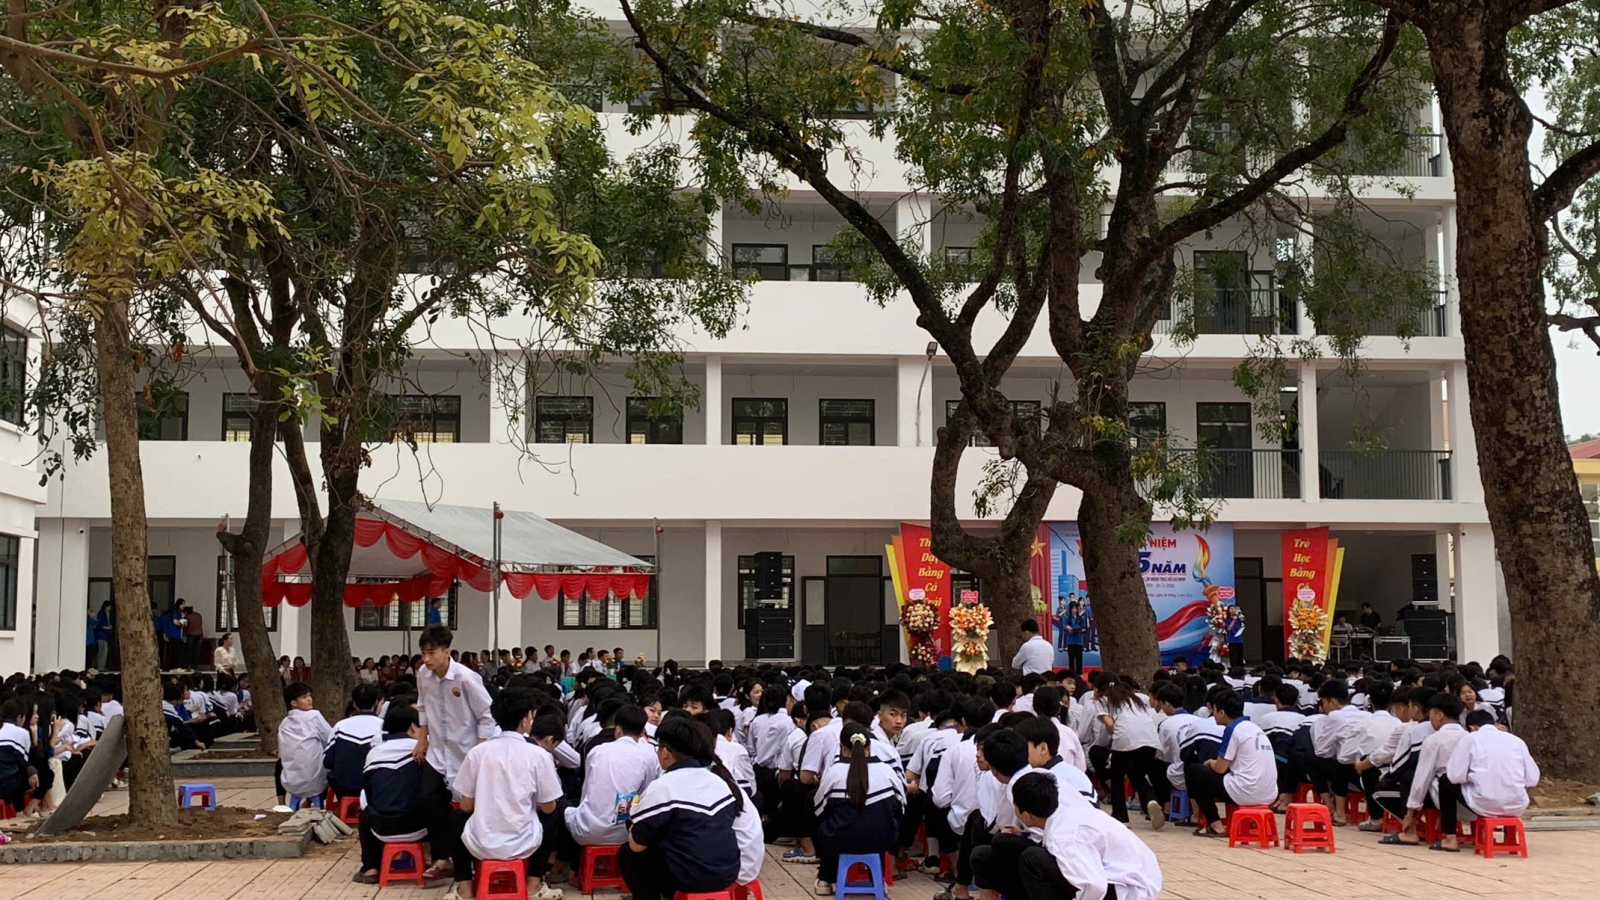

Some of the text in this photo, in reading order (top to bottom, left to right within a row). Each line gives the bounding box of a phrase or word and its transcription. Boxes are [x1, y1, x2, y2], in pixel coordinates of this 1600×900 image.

[919, 537, 932, 547] Th
[1150, 536, 1177, 551] NIỆM
[1294, 538, 1311, 548] Trò
[1138, 551, 1186, 574] 5 NĂM
[1293, 553, 1312, 565] Học
[924, 582, 938, 592] Cả
